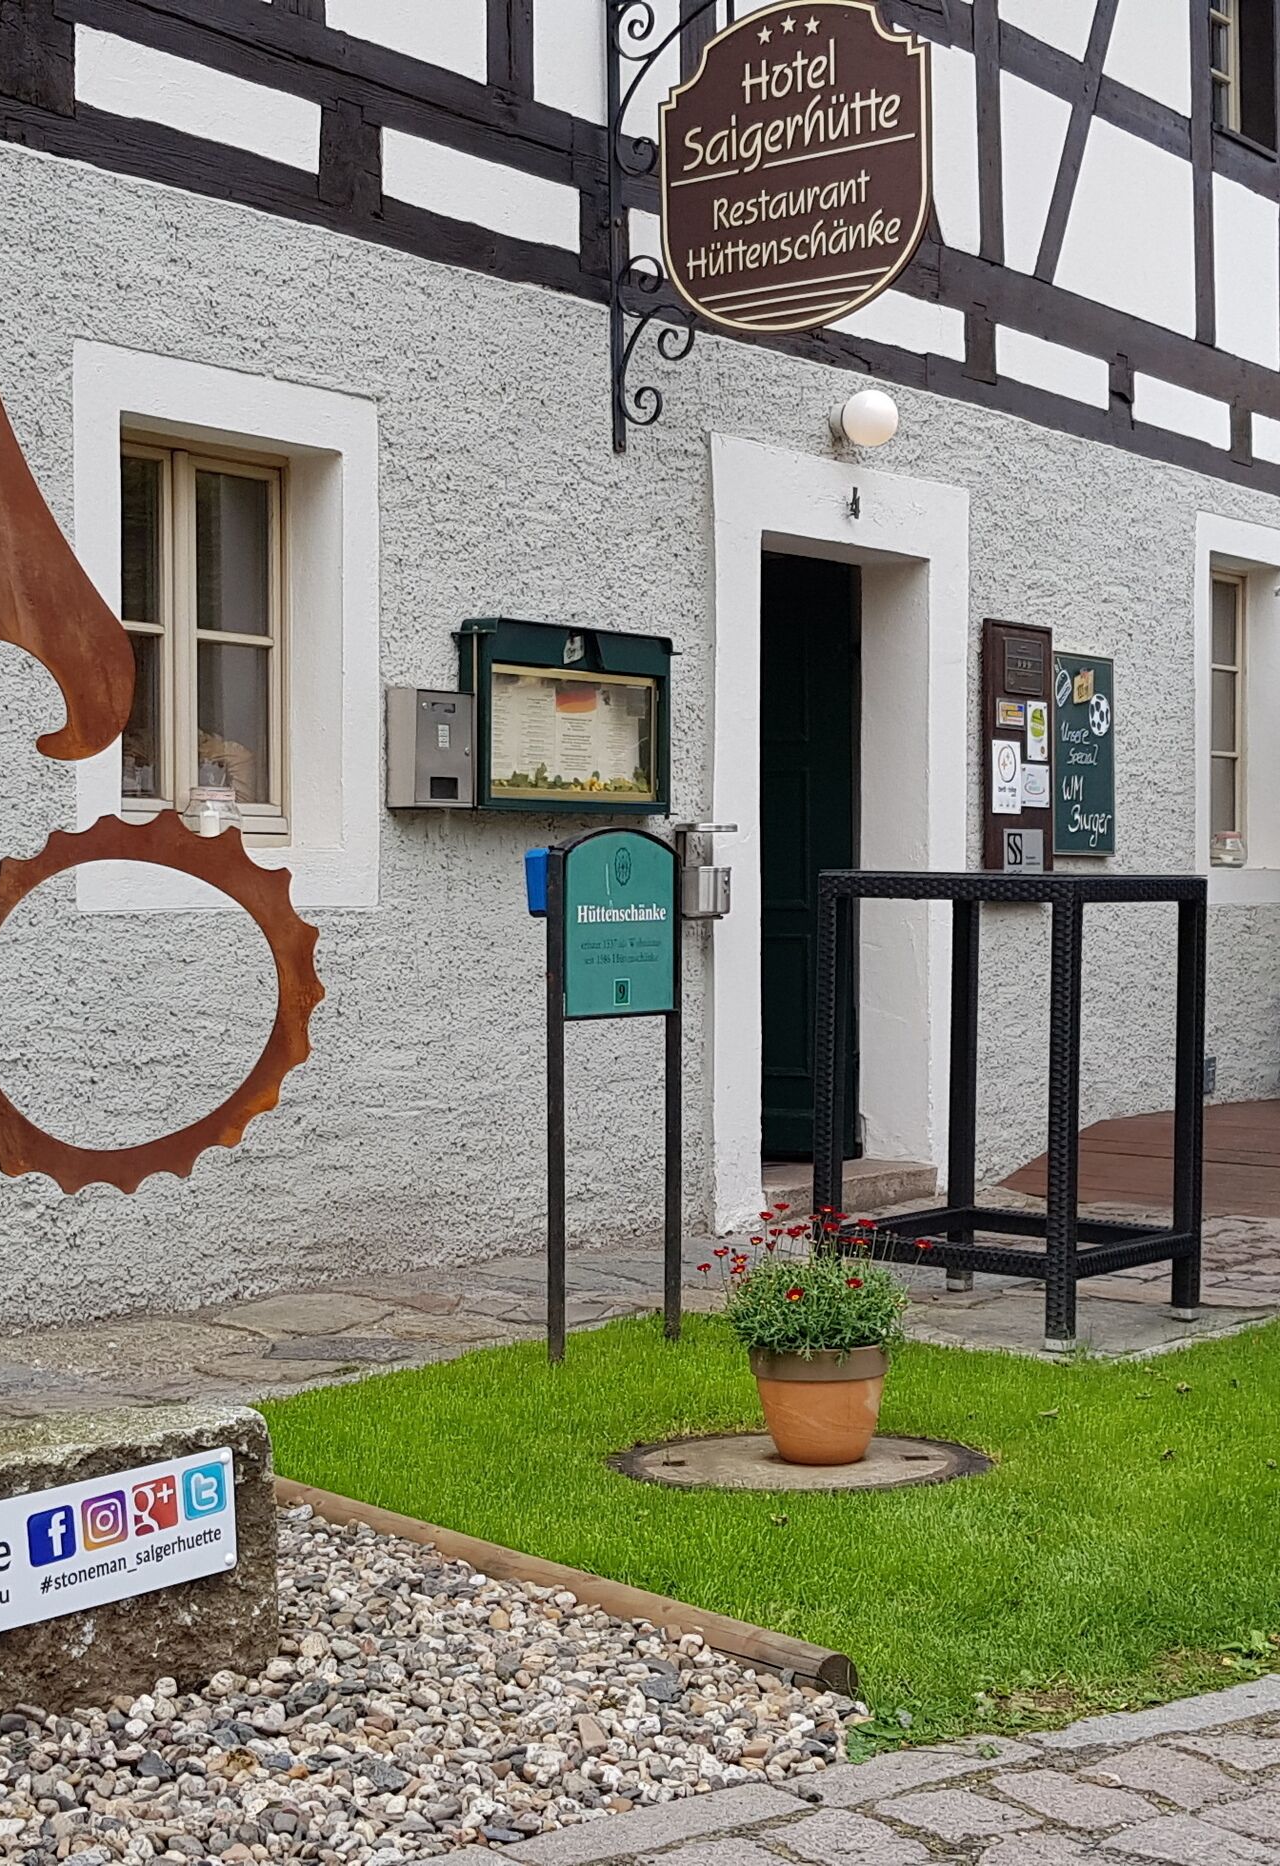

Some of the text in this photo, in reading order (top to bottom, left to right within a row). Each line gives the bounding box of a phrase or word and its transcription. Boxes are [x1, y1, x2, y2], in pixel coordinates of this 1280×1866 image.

[741, 37, 837, 104] Hotel
[682, 88, 901, 173] Saigerhütte
[712, 169, 870, 231] Restaurant
[686, 208, 902, 281] Hüttenschänke
[1062, 775, 1084, 801] WM
[1067, 803, 1113, 848] Burger
[576, 903, 667, 924] Hüttenschänke
